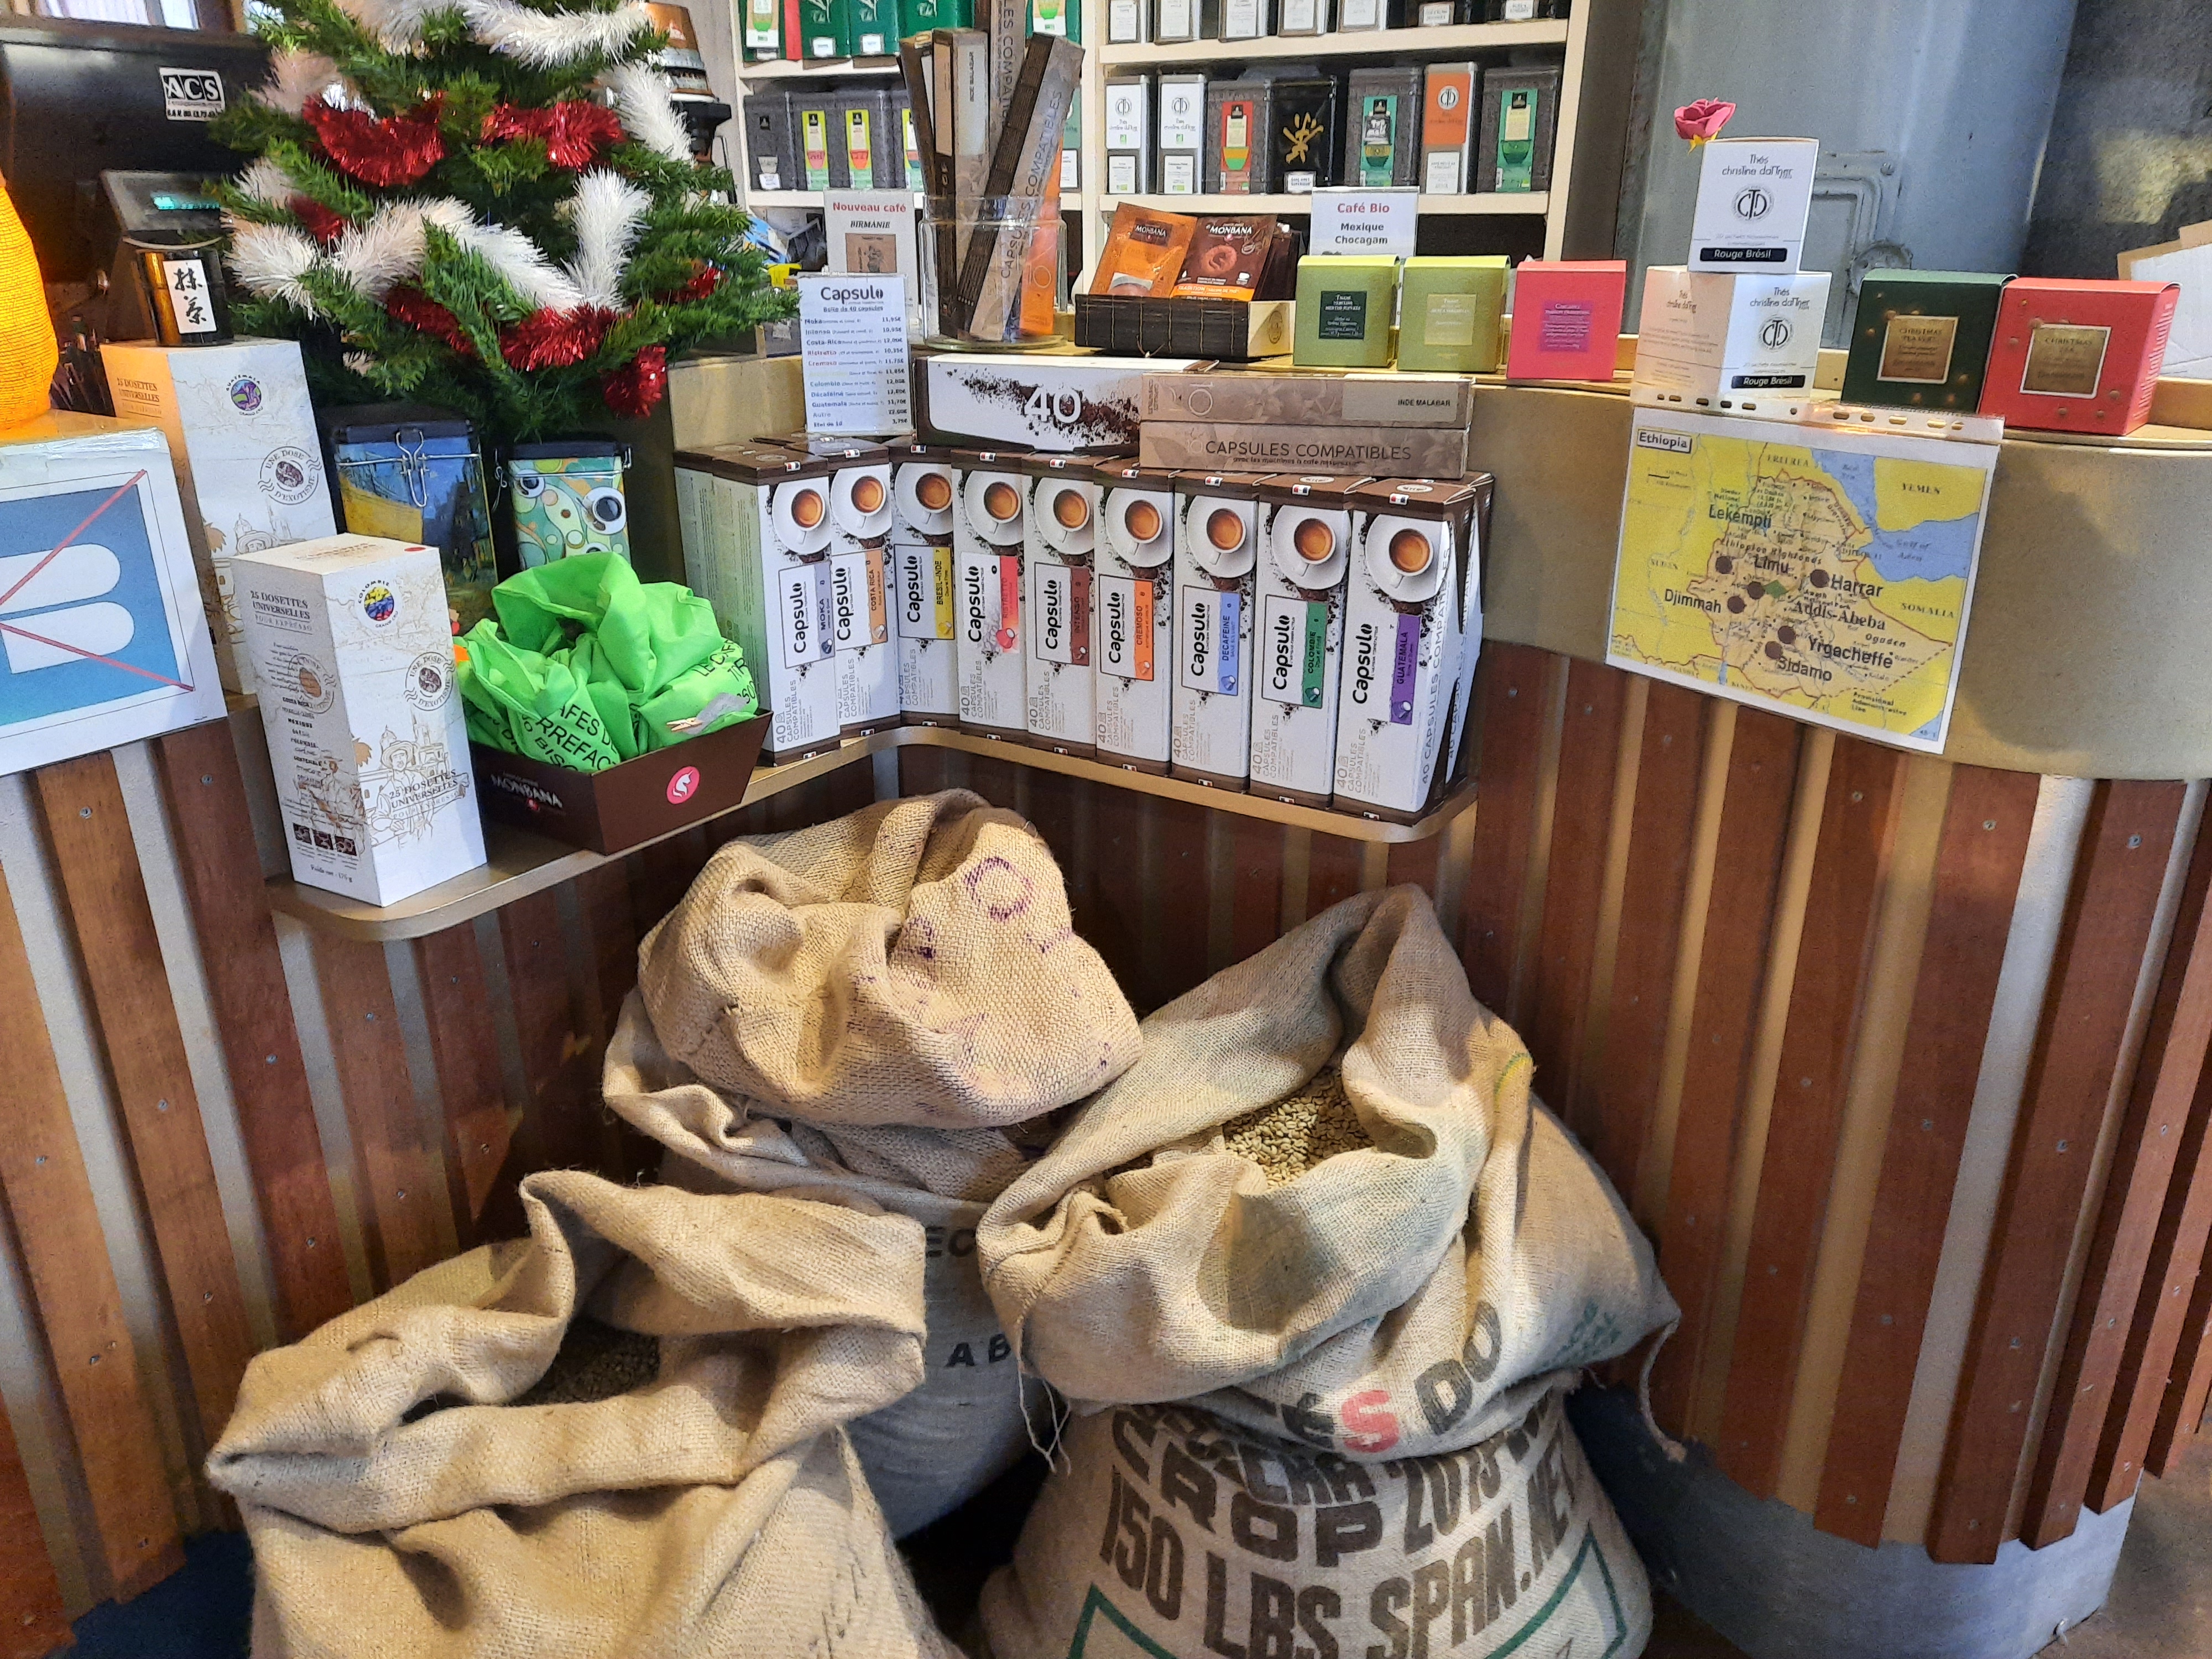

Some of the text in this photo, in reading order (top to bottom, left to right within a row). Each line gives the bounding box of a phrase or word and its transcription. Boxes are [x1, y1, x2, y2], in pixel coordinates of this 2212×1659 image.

[163, 76, 219, 100] ACS
[832, 202, 880, 212] Nouveau
[1337, 201, 1390, 213] Café Bio
[1340, 222, 1385, 233] Mexique
[1334, 235, 1388, 246] Chocagam
[1714, 249, 1743, 259] Rouge
[124, 379, 158, 392] DOSETTES
[1743, 377, 1769, 386] Rouge
[1024, 387, 1083, 424] 40
[1206, 440, 1412, 460] CAPSULES COMPATIBLES
[1639, 432, 1688, 450] Ethiopia
[265, 450, 305, 469] UNE DOSE
[1902, 482, 1941, 494] YEMEN
[1754, 556, 1790, 576] Limu
[358, 580, 390, 604] COLOMBIE
[1830, 573, 1884, 598] Harrar
[250, 589, 309, 609] 25 DOSETTES
[869, 589, 877, 612] COSTA
[1664, 588, 1722, 614] Djimmah
[252, 600, 311, 620] UNIVERSELLES
[1794, 601, 1886, 631] Addis-Abeba
[1900, 602, 1955, 619] SOMALIA
[1222, 614, 1230, 661] DECAFEINE
[409, 654, 443, 677] UNE DOSE
[1396, 632, 1409, 685] GUATEMALA
[1778, 656, 1833, 681] Sidamo
[1425, 675, 1439, 761] CAPSULES
[389, 768, 457, 800] 25 DOSETTES
[1422, 764, 1431, 785] 40
[390, 779, 458, 808] UNIVERSELLES
[1100, 1464, 1185, 1621] 150
